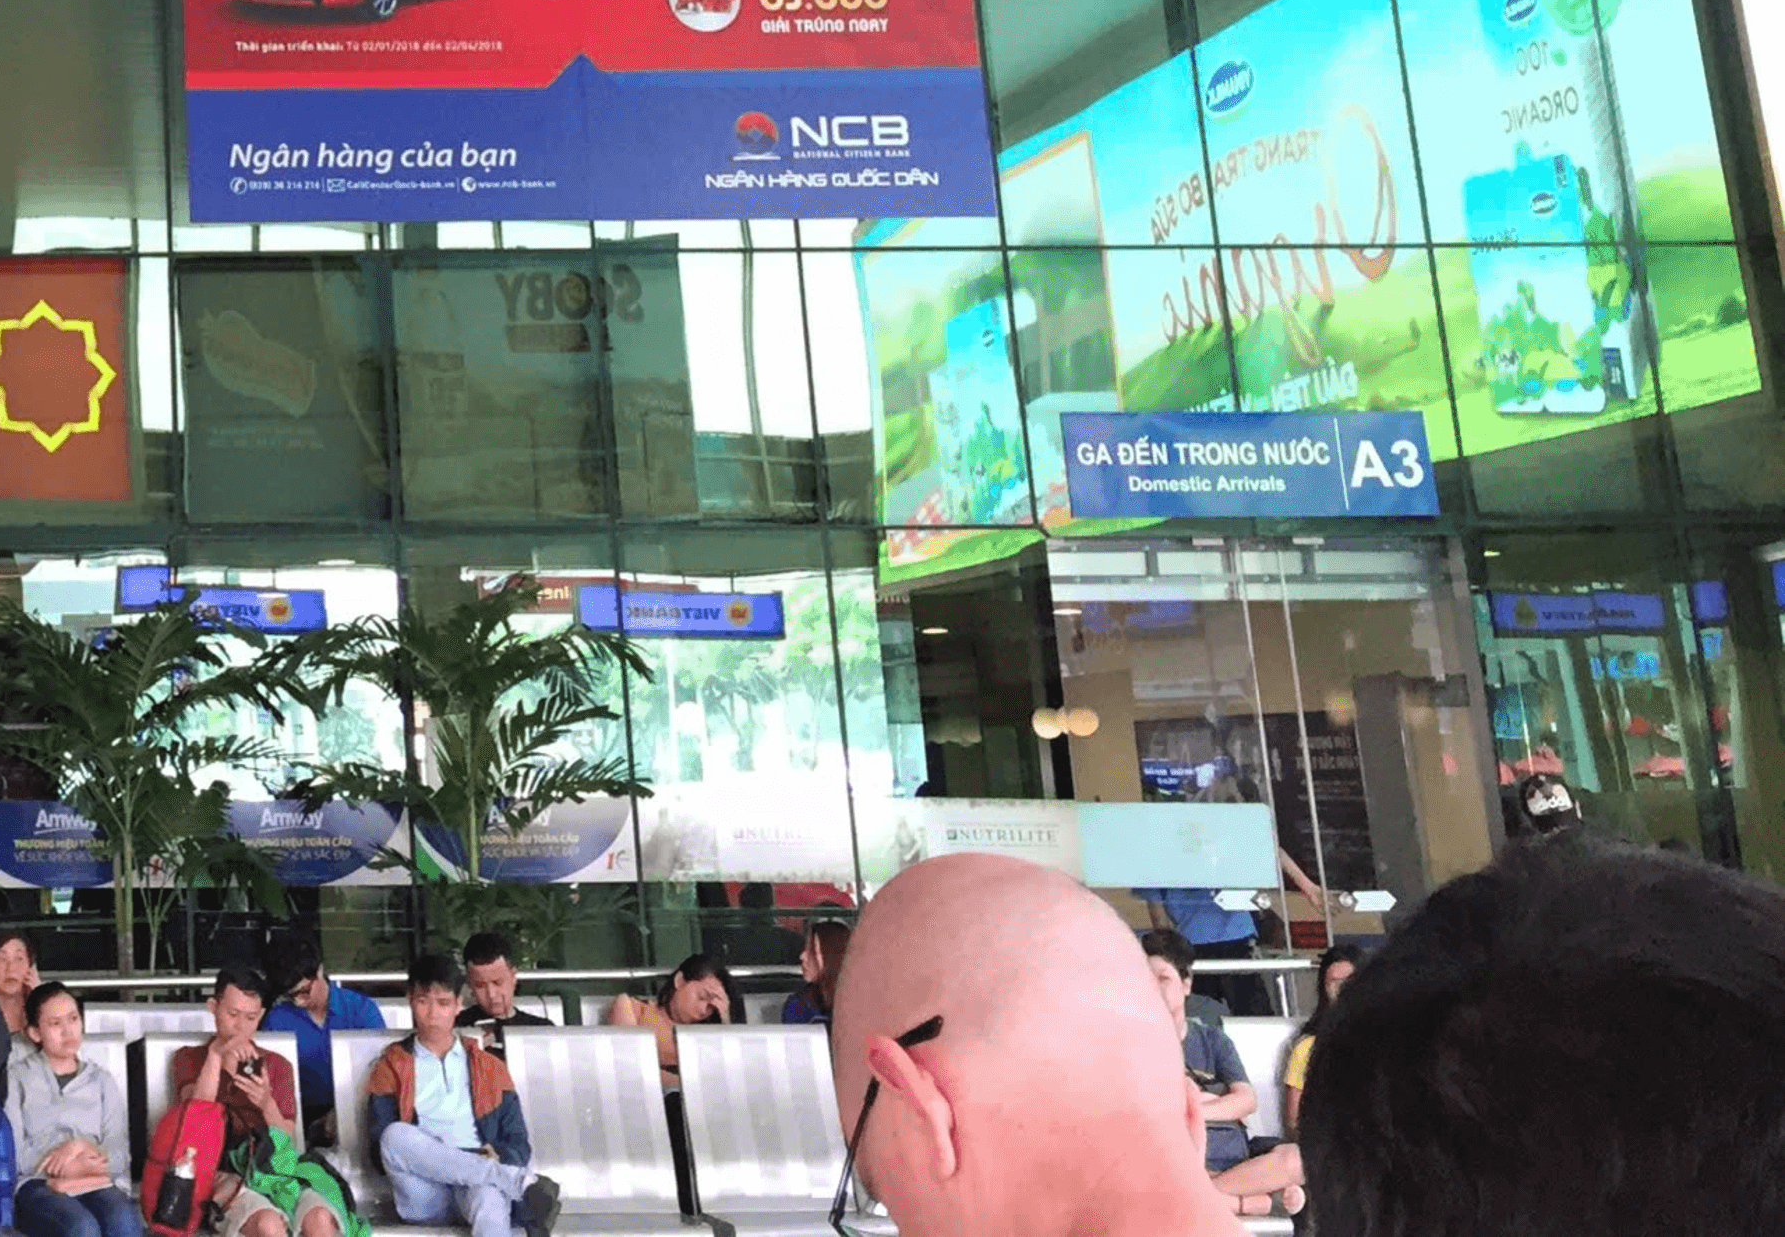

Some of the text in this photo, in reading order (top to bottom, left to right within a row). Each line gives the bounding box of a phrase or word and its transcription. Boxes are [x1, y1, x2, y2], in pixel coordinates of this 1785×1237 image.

[849, 18, 889, 33] NGAY
[790, 115, 909, 147] NCB
[229, 140, 517, 174] Ngân hàng của bạn
[704, 167, 939, 188] NGÂN HÀNG QUỐC DÂN
[1076, 435, 1331, 466] GA ĐẾN TRONG NƯỚC
[1351, 439, 1425, 488] A3
[1128, 475, 1286, 492] Domestic Arrivals
[960, 827, 1058, 843] NUTRILITE
